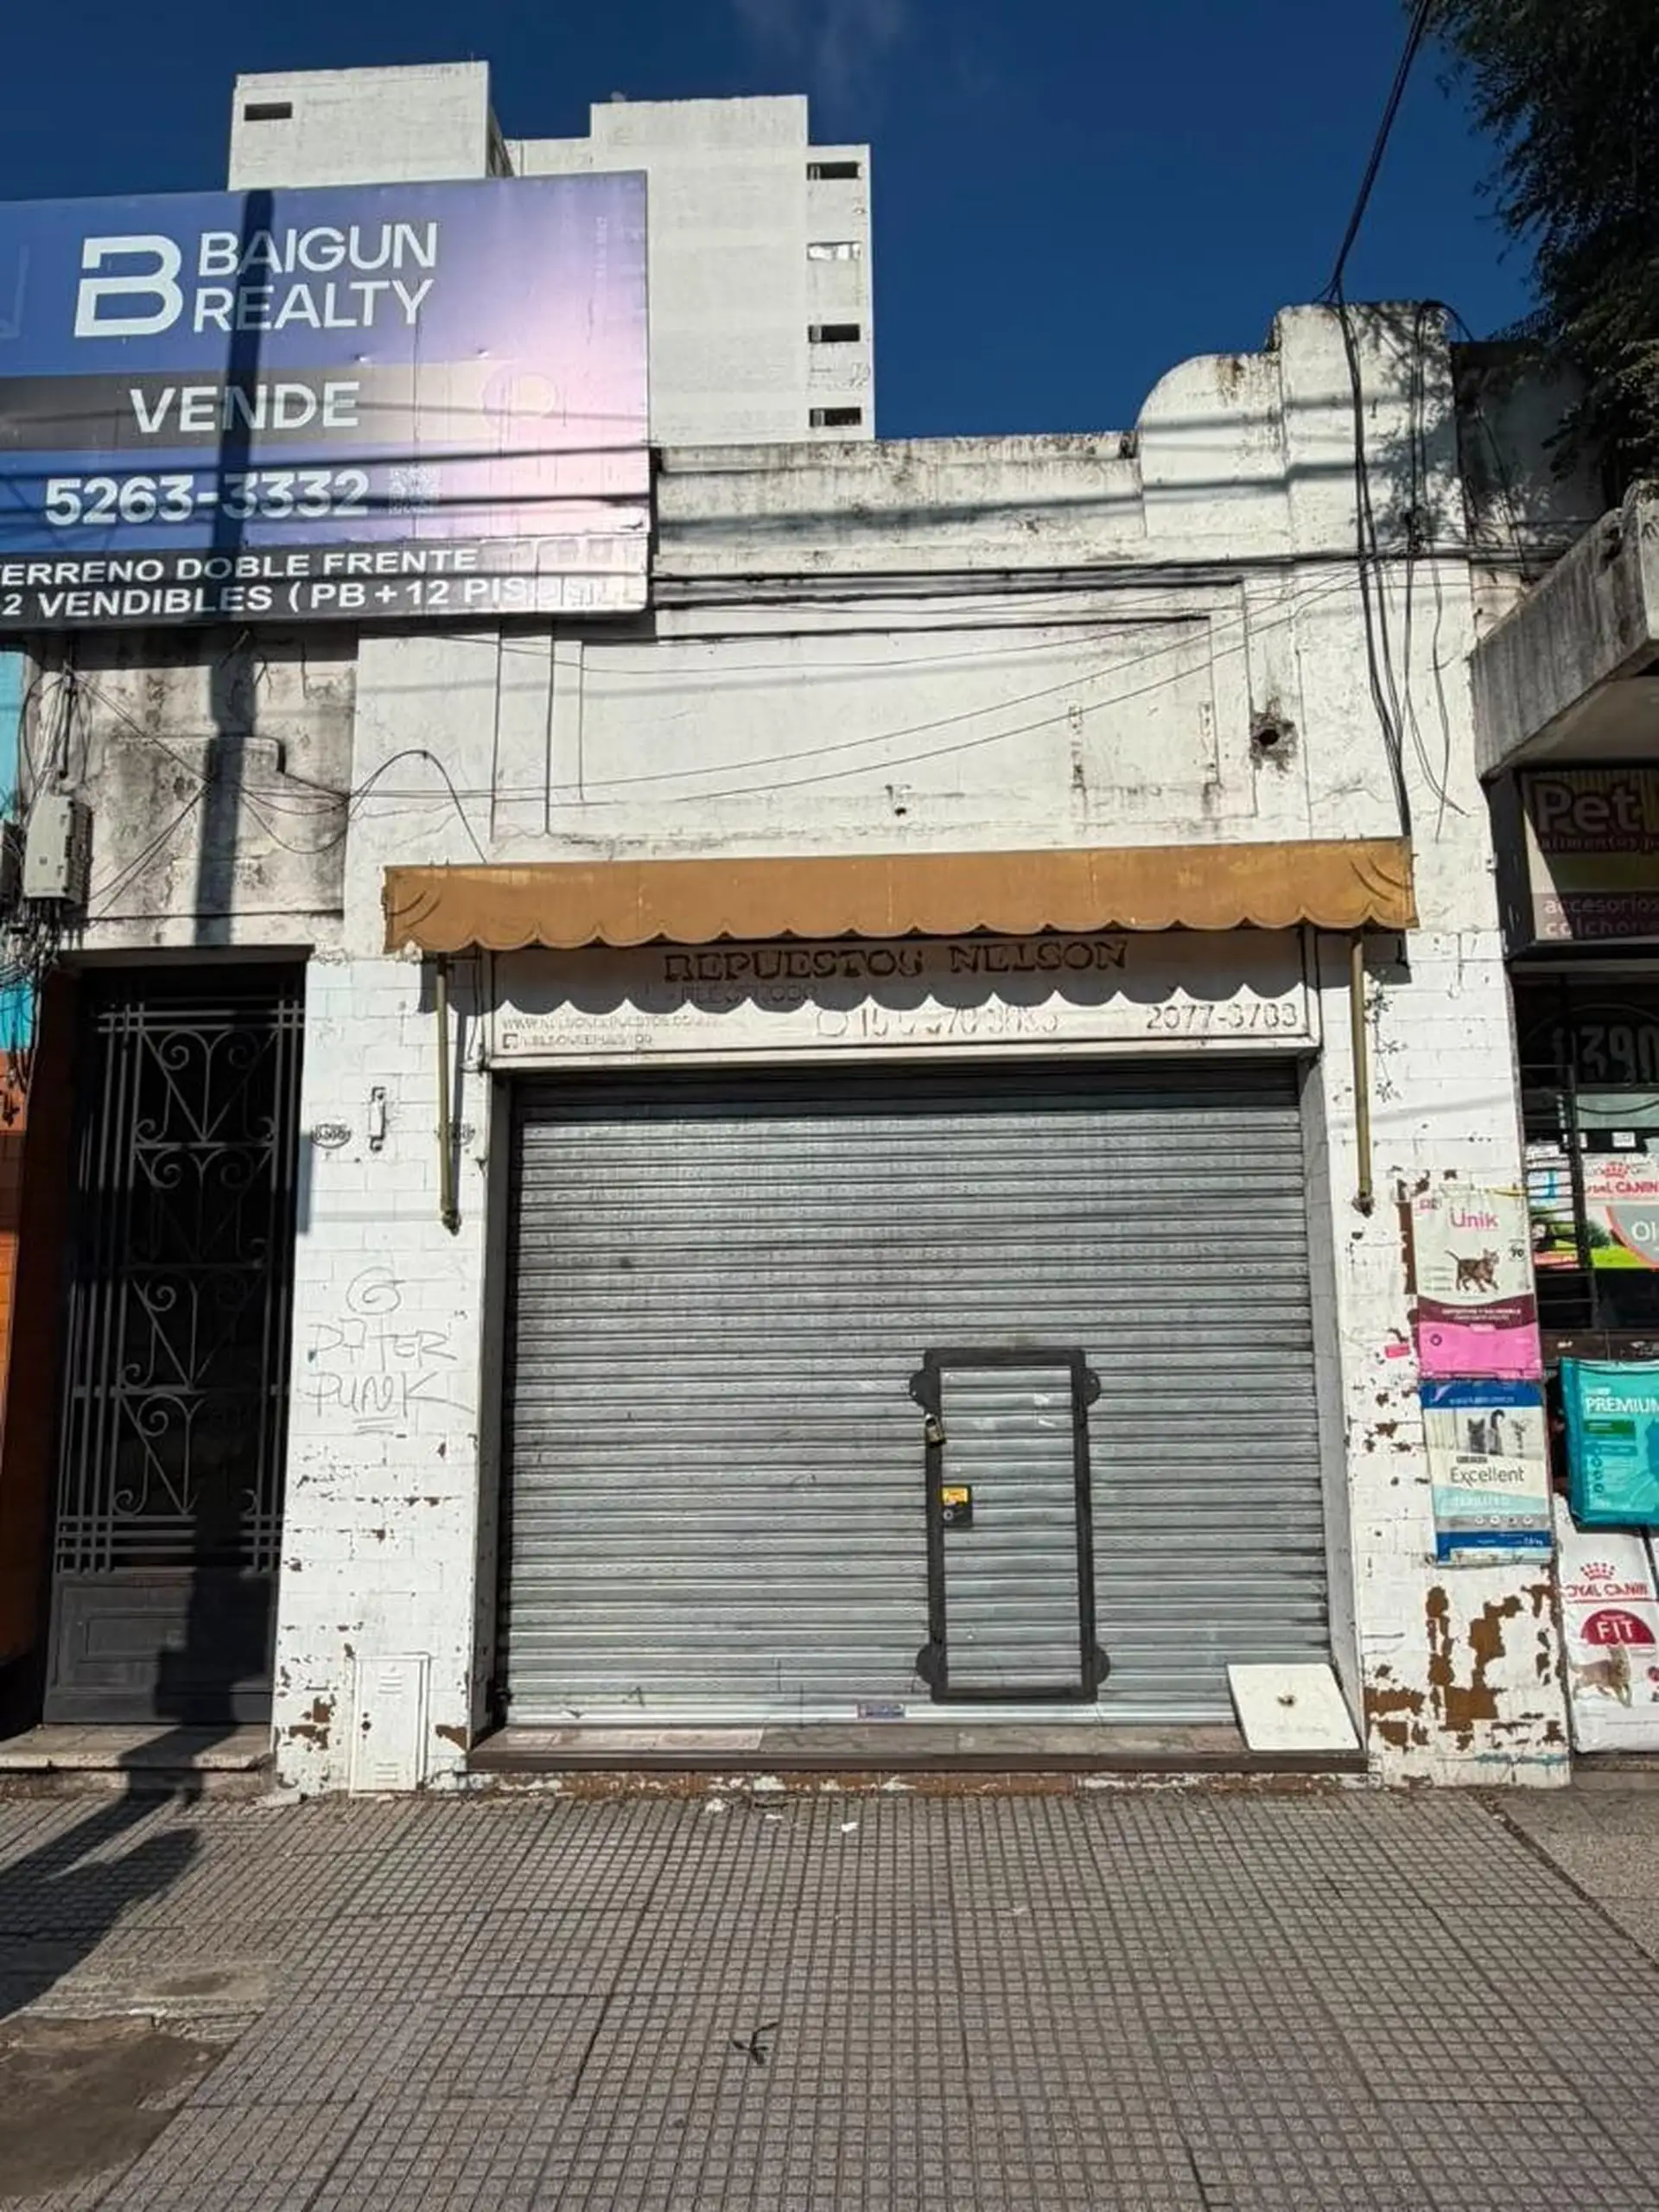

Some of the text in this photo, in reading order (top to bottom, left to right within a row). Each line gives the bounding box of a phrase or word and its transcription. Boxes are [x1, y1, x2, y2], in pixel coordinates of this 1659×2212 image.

[198, 222, 437, 277] BAIGUN
[194, 278, 434, 334] REALTY
[130, 381, 359, 433] VENDE
[45, 469, 369, 525] 5263-3332
[0, 549, 478, 587] ERRENO DOBLE FRENTE
[39, 585, 272, 618] VENDIBLES
[664, 950, 924, 982] REPUESTOS
[1450, 1465, 1525, 1487] Excellent
[1597, 1620, 1636, 1640] FIT
